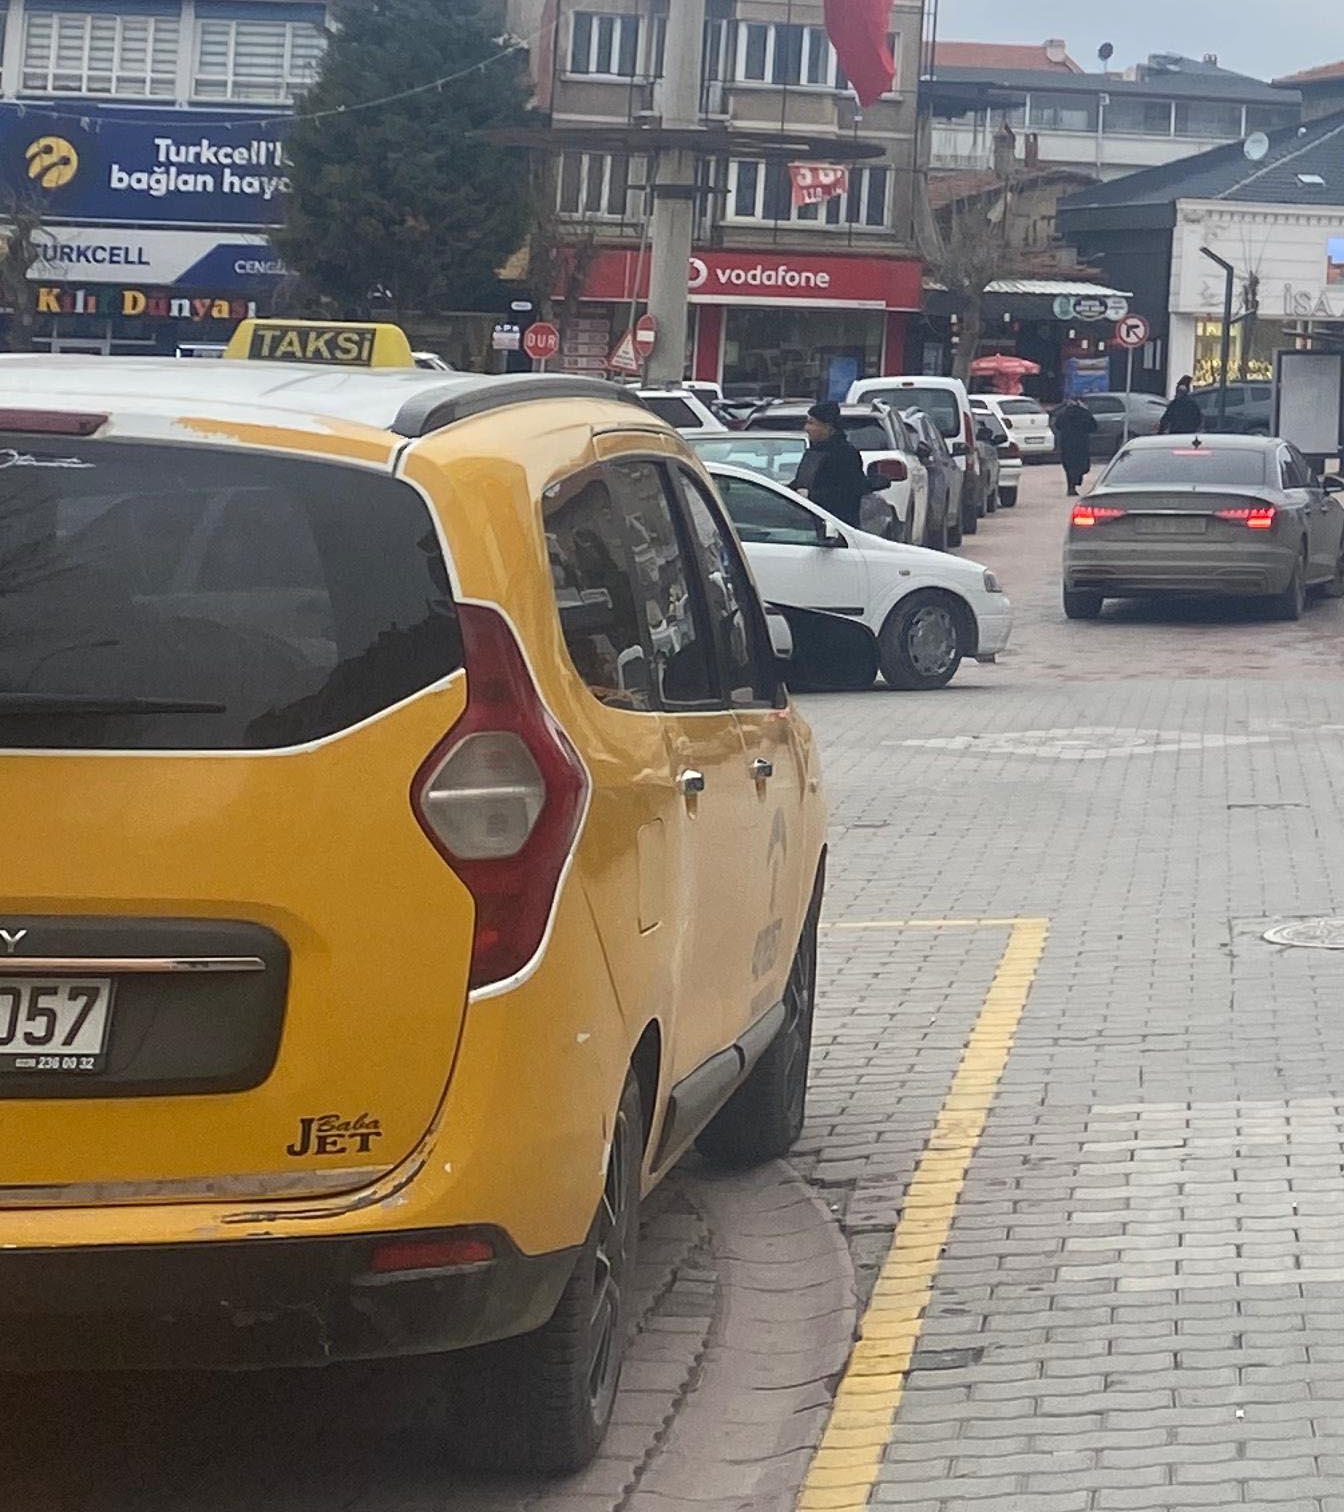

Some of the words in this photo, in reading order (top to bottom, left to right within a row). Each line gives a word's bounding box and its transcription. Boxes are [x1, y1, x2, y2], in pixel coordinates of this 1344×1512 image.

[110, 164, 215, 197] bağlan
[716, 265, 830, 287] vodafone
[1284, 284, 1339, 317] İSA
[526, 332, 557, 349] DUR
[316, 1112, 380, 1132] Baba
[286, 1118, 383, 1156] JET
